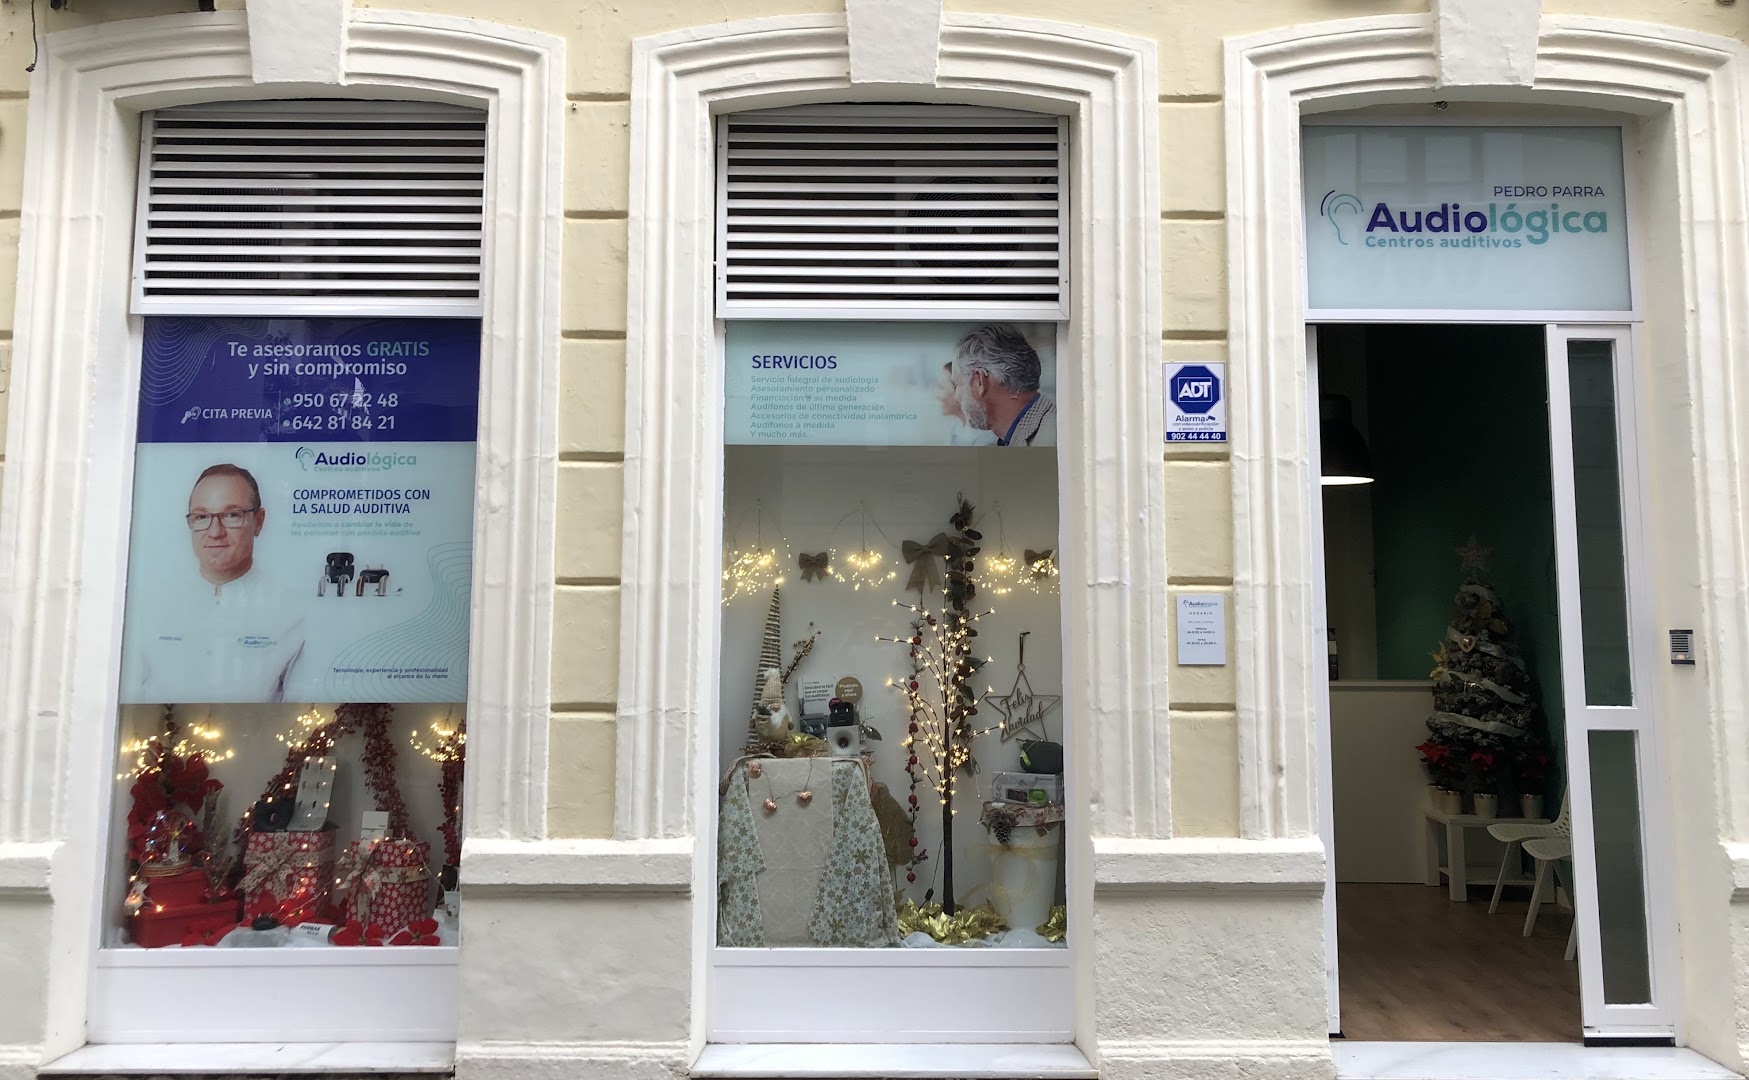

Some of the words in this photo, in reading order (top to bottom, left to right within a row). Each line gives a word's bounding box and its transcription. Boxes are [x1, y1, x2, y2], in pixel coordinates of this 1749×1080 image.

[1493, 186, 1548, 197] PEDRO
[1552, 186, 1605, 197] PARRA
[1365, 202, 1608, 245] Audiológica
[1365, 236, 1434, 248] Centros
[1440, 235, 1522, 248] auditivos
[228, 341, 248, 357] Te
[253, 343, 361, 357] asesoramos
[366, 341, 430, 357] GRATIS
[752, 355, 837, 369] SERVICIOS
[248, 363, 259, 379] y
[263, 359, 290, 375] sin
[295, 359, 407, 379] compromiso
[750, 375, 785, 383] Servicio
[834, 376, 879, 385] audiología
[816, 385, 875, 393] personalizado
[1178, 381, 1212, 398] ADT
[293, 393, 324, 408] 950
[329, 393, 349, 408] 67
[352, 393, 373, 408] 22
[377, 393, 399, 408] 48
[750, 393, 804, 401] Financiación
[750, 403, 794, 411] Audífonos
[796, 403, 807, 411] de
[809, 402, 836, 411] última
[837, 403, 885, 412] generación
[202, 408, 228, 419] CITA
[231, 408, 273, 419] PREVIA
[750, 412, 797, 420] Accesorios
[798, 412, 810, 420] de
[811, 412, 866, 420] conectividad
[868, 412, 918, 420] inalámbrica
[1175, 414, 1206, 422] Alarma
[292, 415, 323, 430] 642
[327, 415, 346, 430] 81
[351, 415, 373, 430] 84
[377, 415, 395, 430] 21
[750, 421, 794, 429] Audífonos
[803, 421, 835, 429] medida
[750, 430, 756, 438] Y
[758, 430, 787, 438] mucho
[1171, 432, 1186, 440] 902
[1187, 432, 1198, 440] 44
[1199, 432, 1210, 440] 44
[1211, 432, 1221, 440] 40
[314, 452, 417, 470] Audiológica
[293, 489, 401, 500] COMPROMETIDOS
[404, 489, 430, 500] CON
[292, 503, 308, 514] LA
[310, 503, 351, 514] SALUD
[353, 503, 411, 514] AUDITIVA
[384, 520, 402, 528] vida
[1000, 687, 1033, 717] Feliz
[1000, 701, 1044, 739] Navidad
